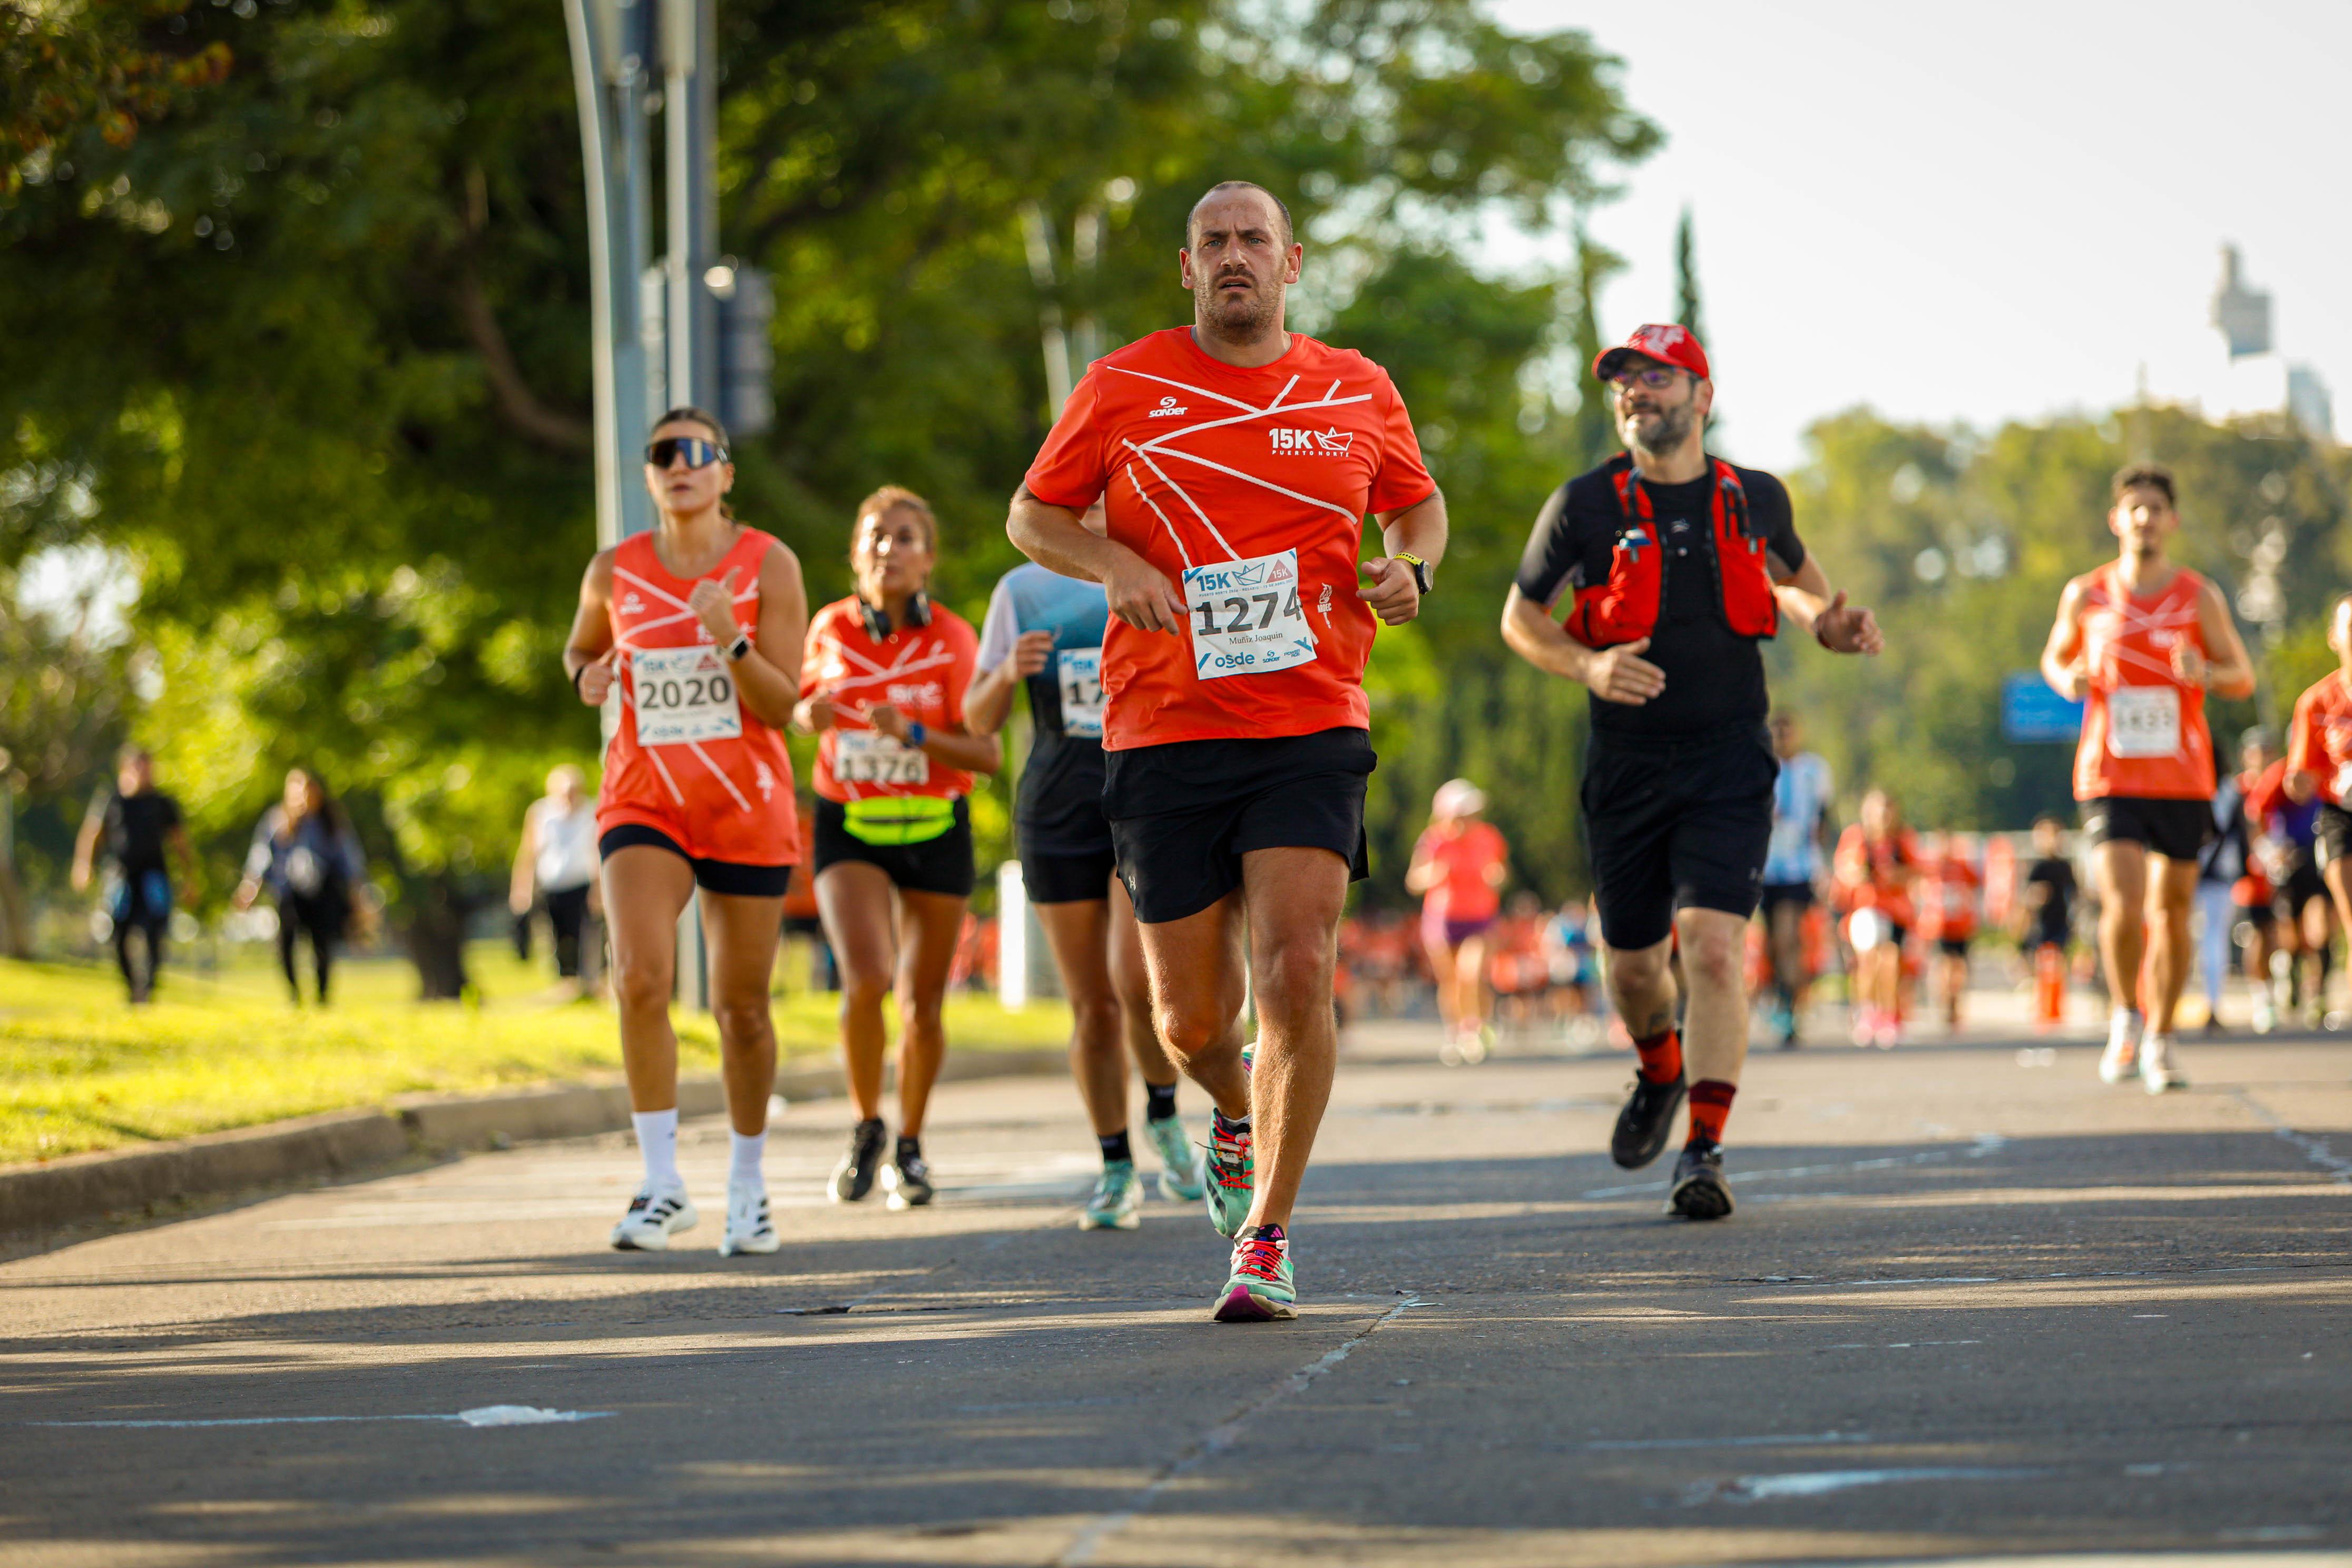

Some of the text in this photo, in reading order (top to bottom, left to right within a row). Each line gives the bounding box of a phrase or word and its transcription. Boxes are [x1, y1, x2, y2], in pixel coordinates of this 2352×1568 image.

[1269, 428, 1313, 449] 15K
[1197, 572, 1231, 592] 15K
[1272, 567, 1288, 579] 15K
[1195, 585, 1302, 636] 1274
[1229, 635, 1252, 645] Muñiz
[1215, 652, 1255, 668] osde
[640, 676, 731, 709] 2020
